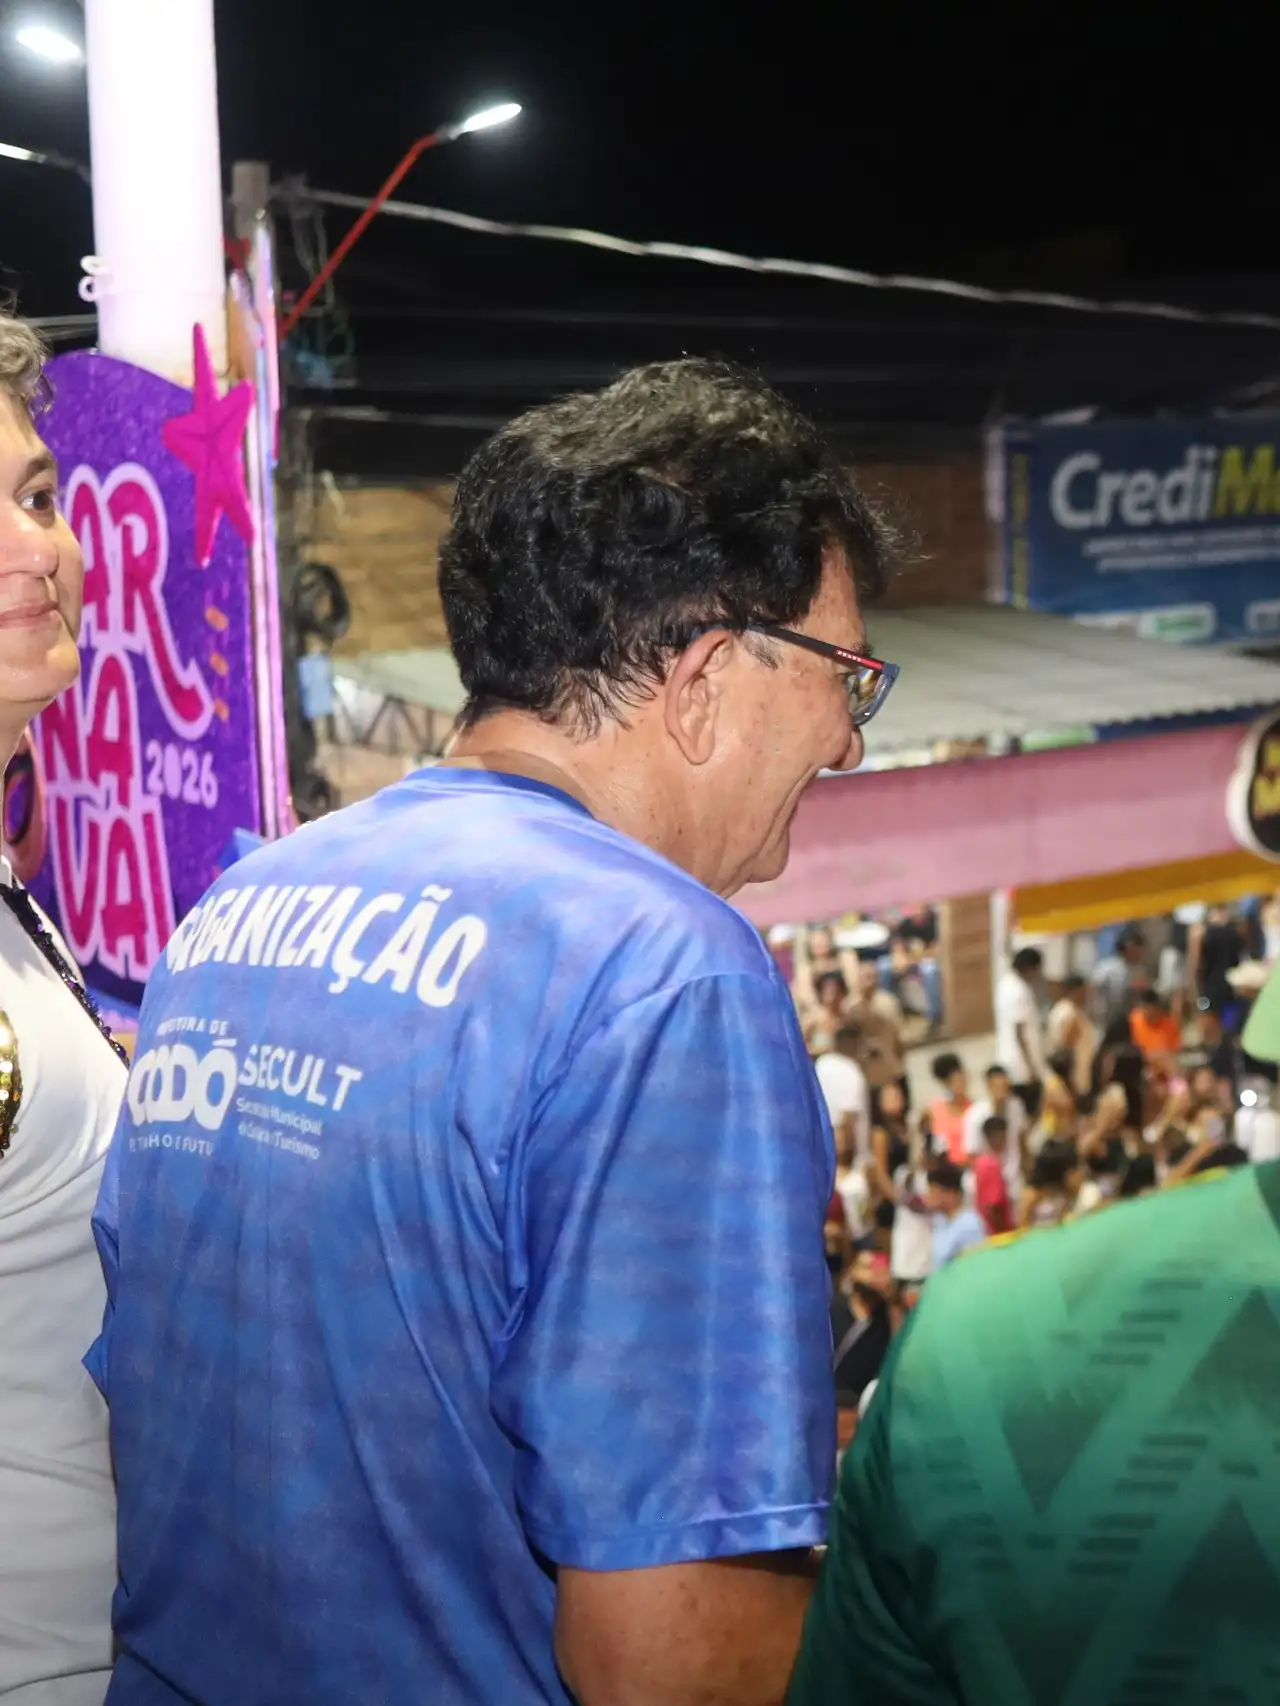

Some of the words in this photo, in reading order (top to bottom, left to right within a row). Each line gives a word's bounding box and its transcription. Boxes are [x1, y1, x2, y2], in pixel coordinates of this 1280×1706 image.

[66, 462, 214, 740] AR
[145, 738, 219, 808] 2026
[209, 1020, 230, 1037] DE
[238, 1044, 363, 1112] SECULT
